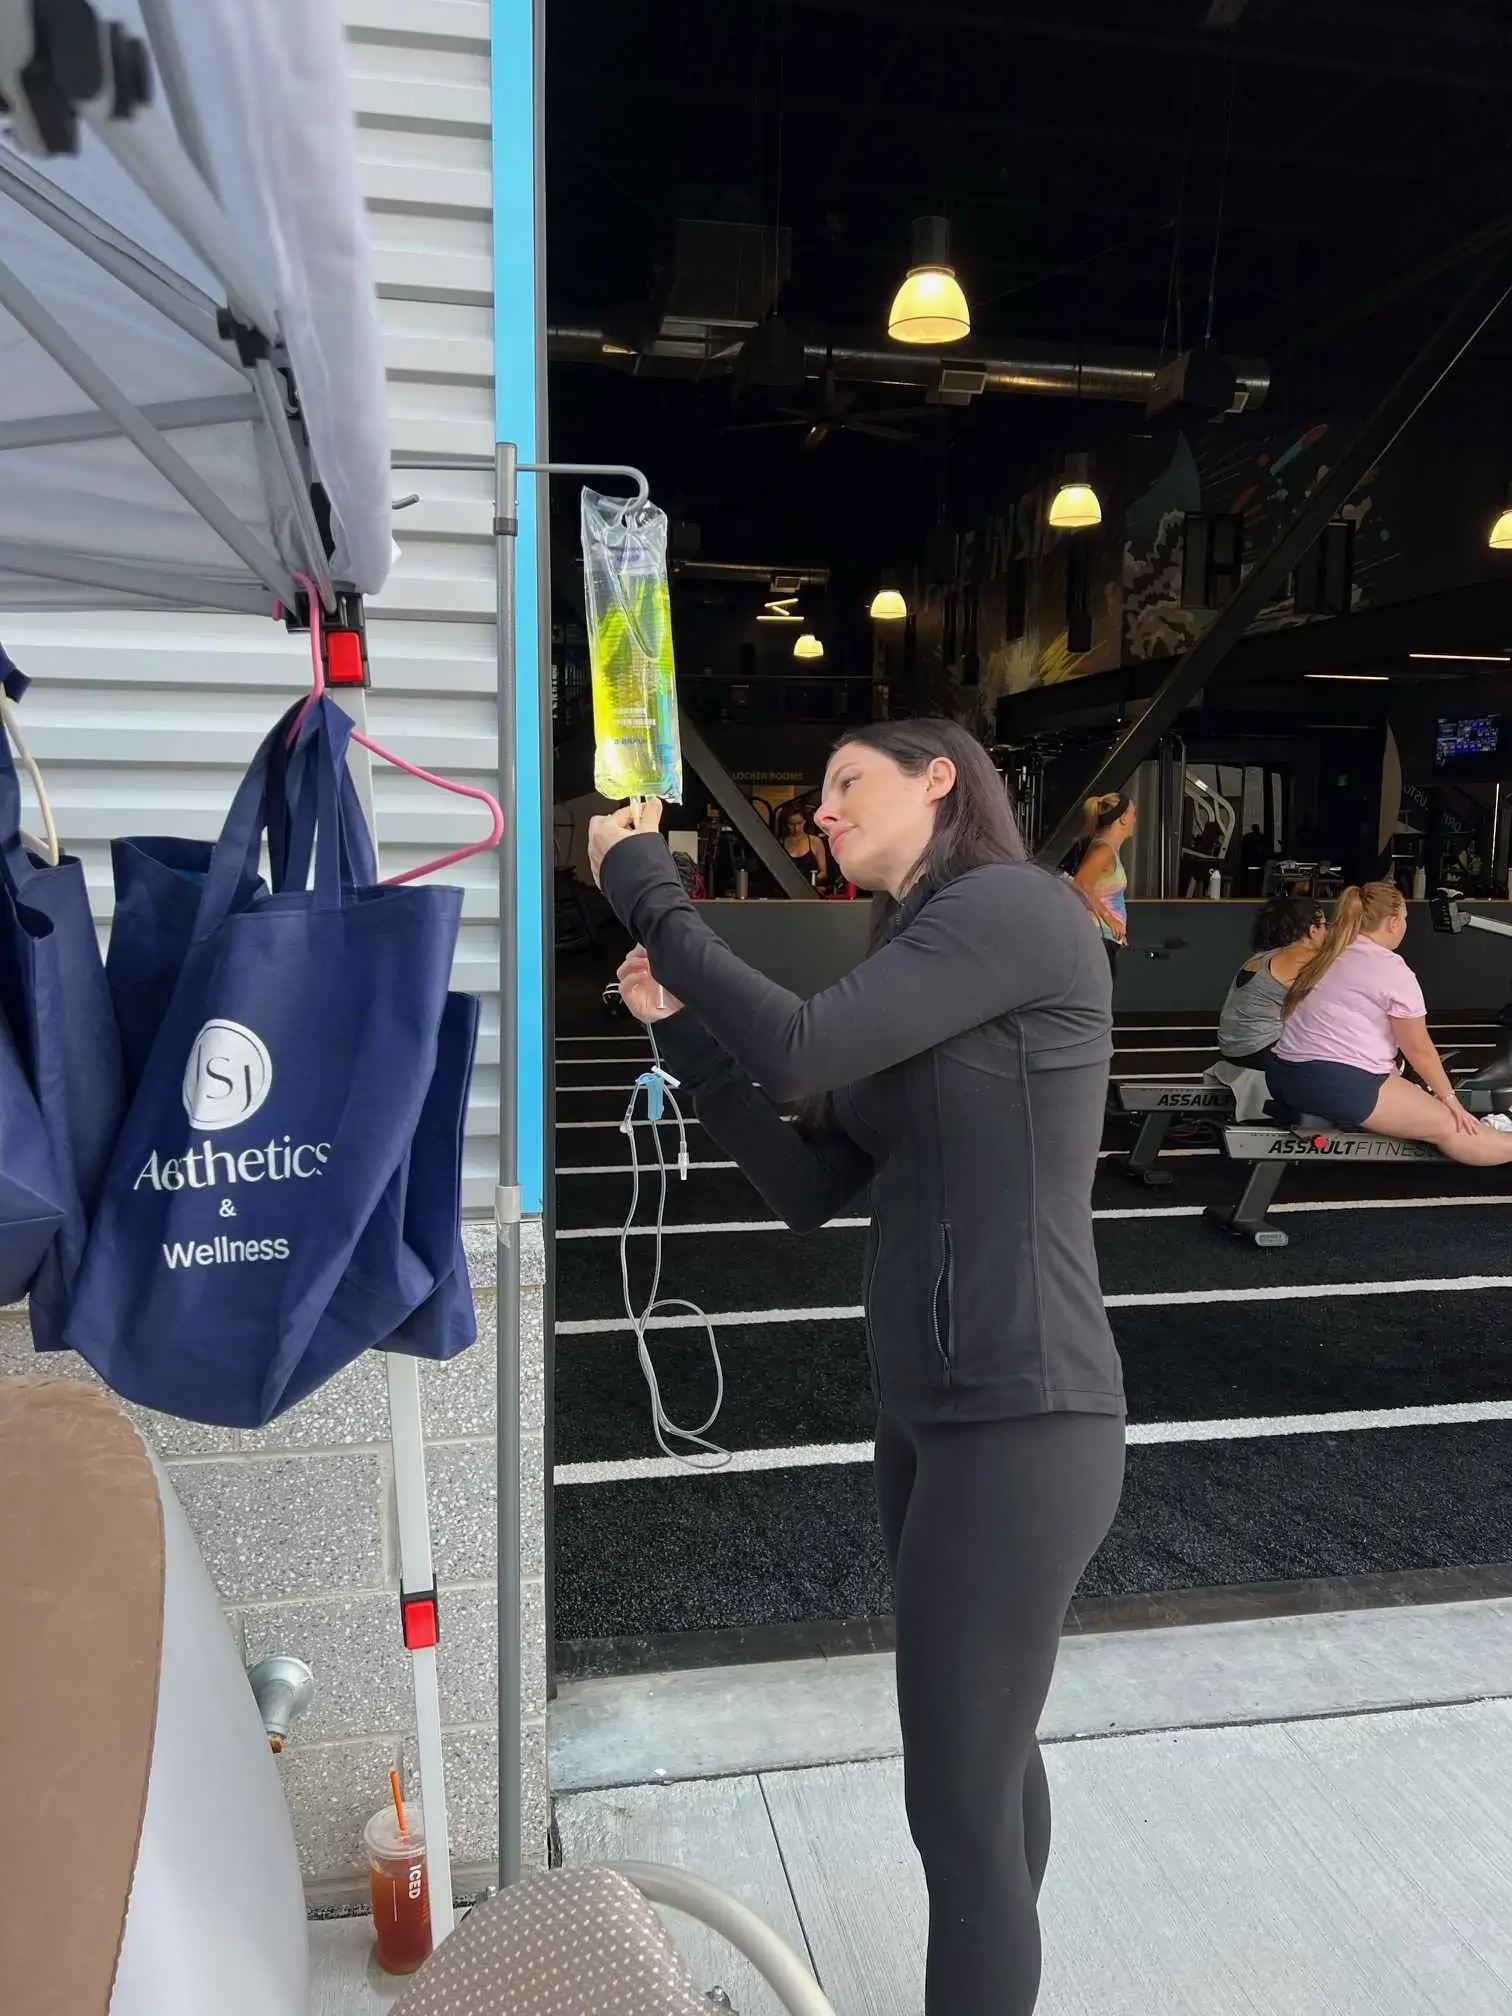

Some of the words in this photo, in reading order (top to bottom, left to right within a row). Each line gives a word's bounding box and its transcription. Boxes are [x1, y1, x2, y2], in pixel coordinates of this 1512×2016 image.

[205, 1056, 252, 1113] SJ
[219, 1199, 237, 1217] &
[162, 1235, 290, 1269] Wellness
[409, 1865, 422, 1899] ICED
